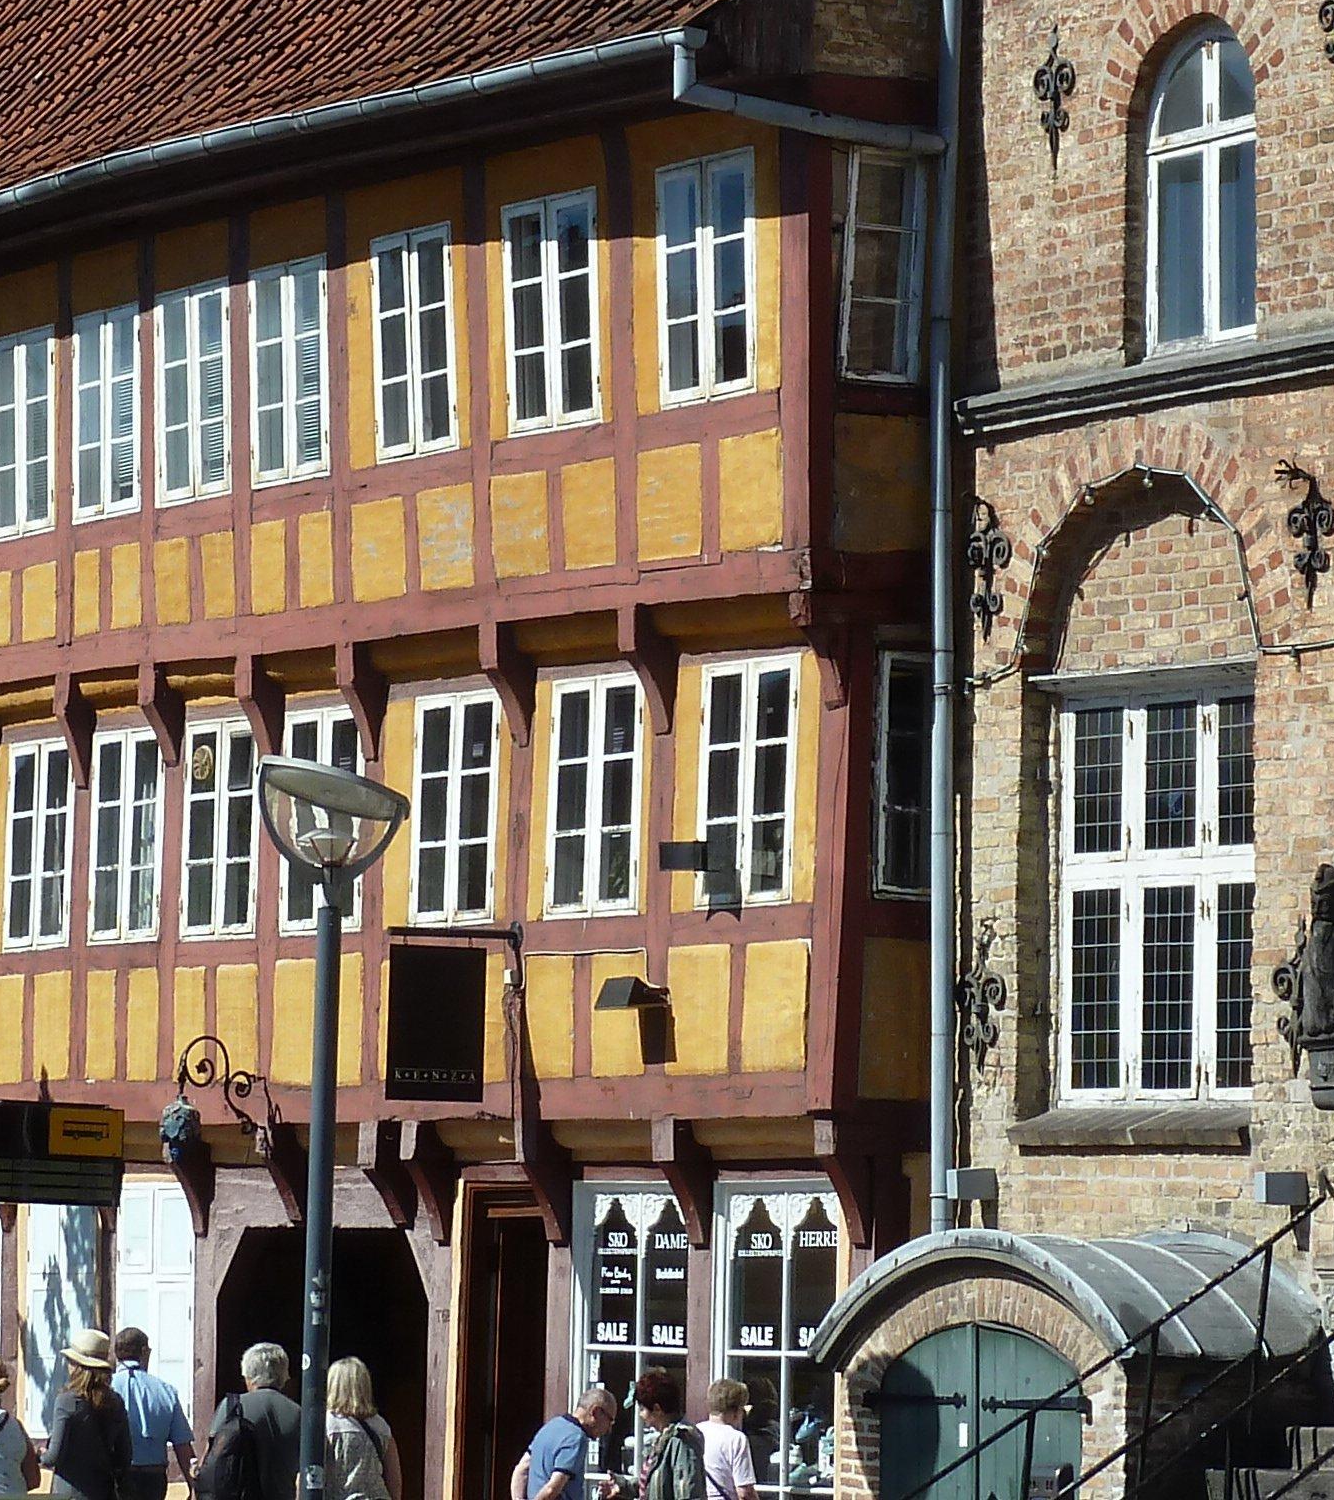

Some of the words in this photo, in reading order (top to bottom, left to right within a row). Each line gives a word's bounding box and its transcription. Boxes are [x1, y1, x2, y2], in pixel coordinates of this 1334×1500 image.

[607, 1232, 628, 1248] SKO
[654, 1233, 688, 1249] DAME
[750, 1232, 773, 1250] SKO
[799, 1230, 837, 1248] HERRE
[596, 1322, 628, 1342] SALE
[651, 1324, 684, 1346] SALE
[740, 1326, 773, 1347] SALE
